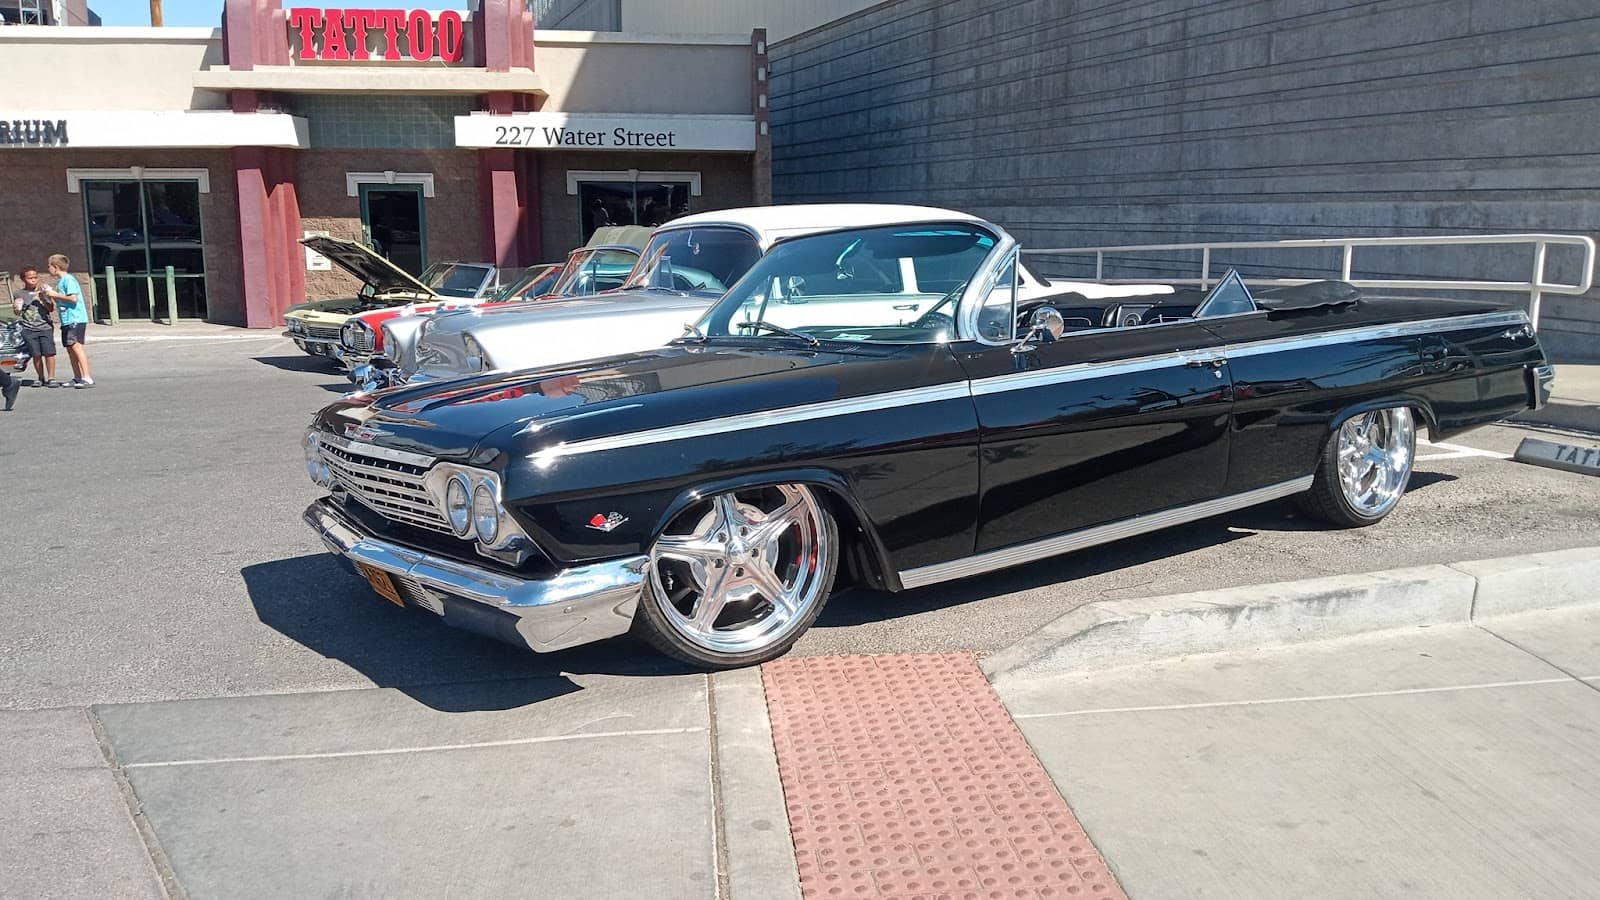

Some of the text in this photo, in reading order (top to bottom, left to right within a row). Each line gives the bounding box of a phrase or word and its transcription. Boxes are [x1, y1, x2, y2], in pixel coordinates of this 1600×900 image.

[291, 8, 464, 62] TATTOO
[495, 126, 676, 147] 227 Water Street
